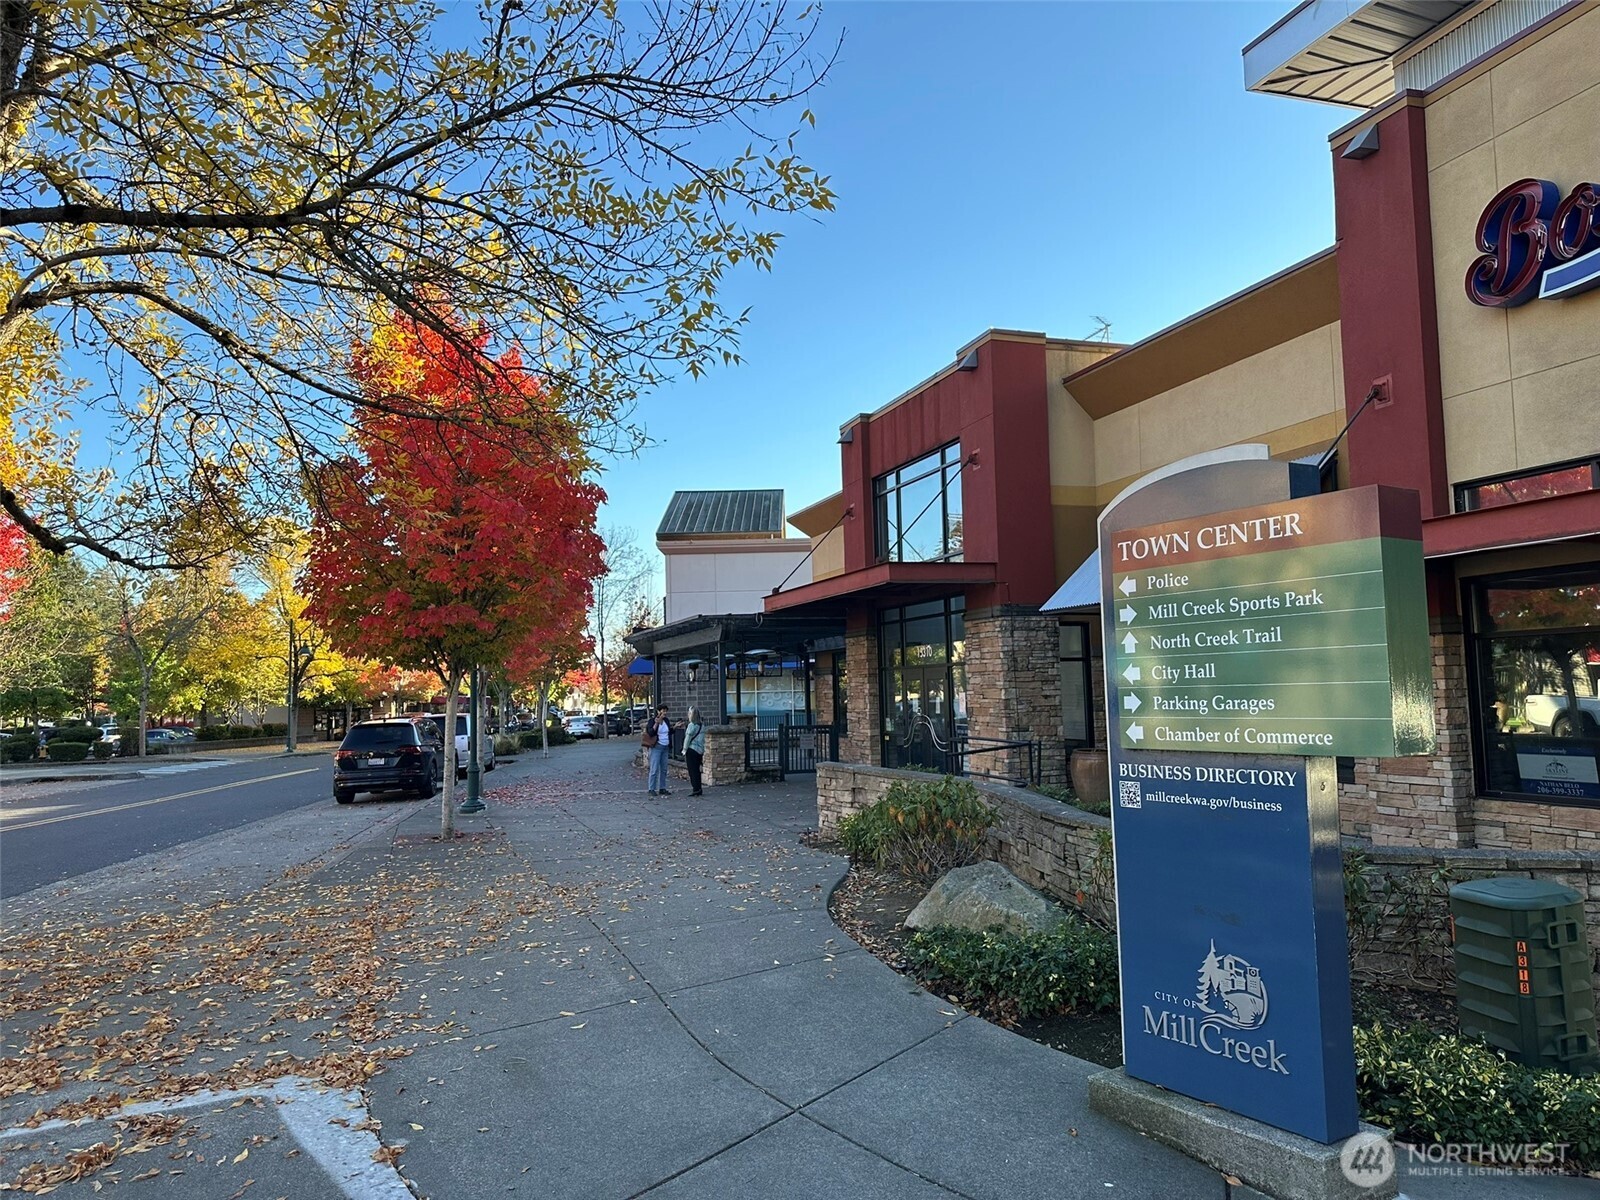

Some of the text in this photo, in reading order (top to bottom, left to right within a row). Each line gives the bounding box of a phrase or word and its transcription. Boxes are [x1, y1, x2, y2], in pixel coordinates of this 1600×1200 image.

[1465, 177, 1600, 308] Bo
[1117, 513, 1304, 561] TOWN CENTER
[1147, 574, 1189, 590] Police
[1148, 589, 1324, 620] Mill Creek Sports Park
[1150, 626, 1282, 650] North Creek Trail
[1151, 663, 1216, 683] City Hall
[1153, 695, 1275, 715] Parking Garages
[1154, 727, 1333, 746] Chamber of Commerce
[1118, 763, 1297, 787] BUSINESS DIRECTORY
[1145, 791, 1282, 812] millcreekwa.gov/business
[1537, 786, 1584, 796] 206-399-3337
[1154, 991, 1198, 1009] CITY OF
[1142, 1005, 1289, 1075] Mill Creek
